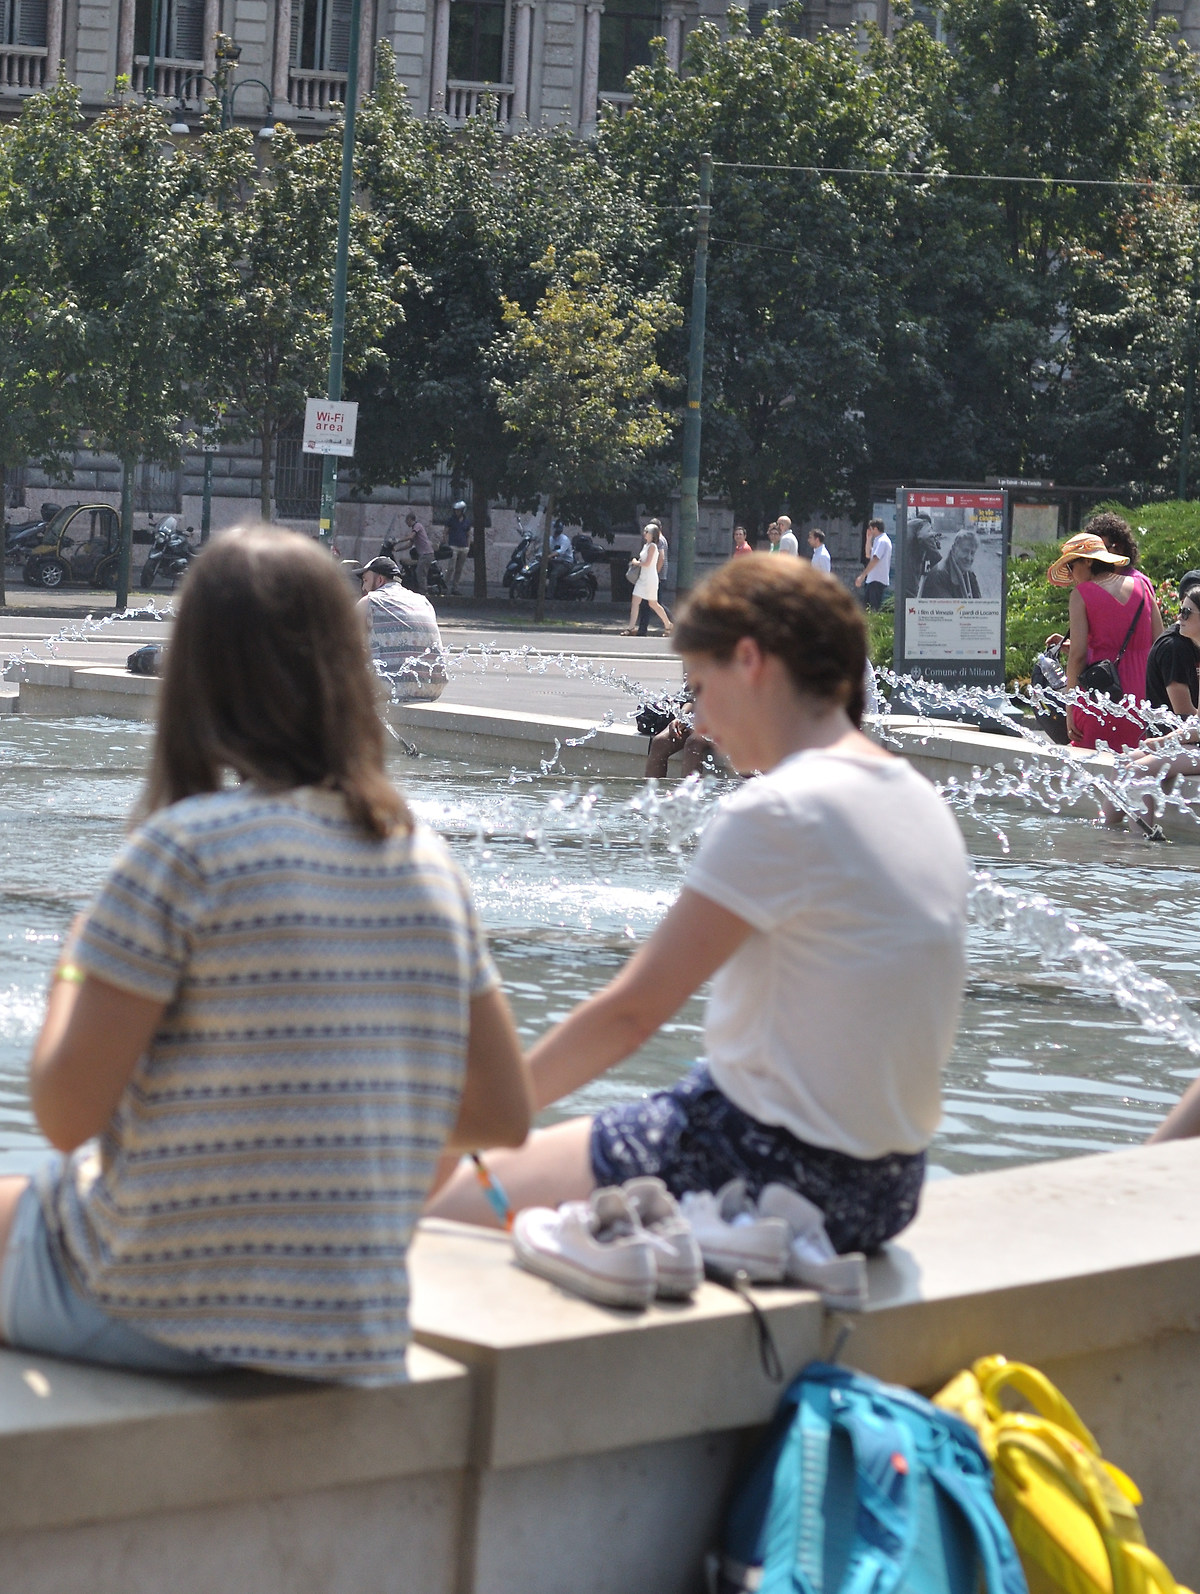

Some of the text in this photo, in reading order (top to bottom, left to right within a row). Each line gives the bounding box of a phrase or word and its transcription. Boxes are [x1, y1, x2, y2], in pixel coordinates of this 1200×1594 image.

[317, 411, 344, 423] Wi-Fi
[316, 422, 342, 431] area
[924, 667, 996, 677] Comune di Milano
